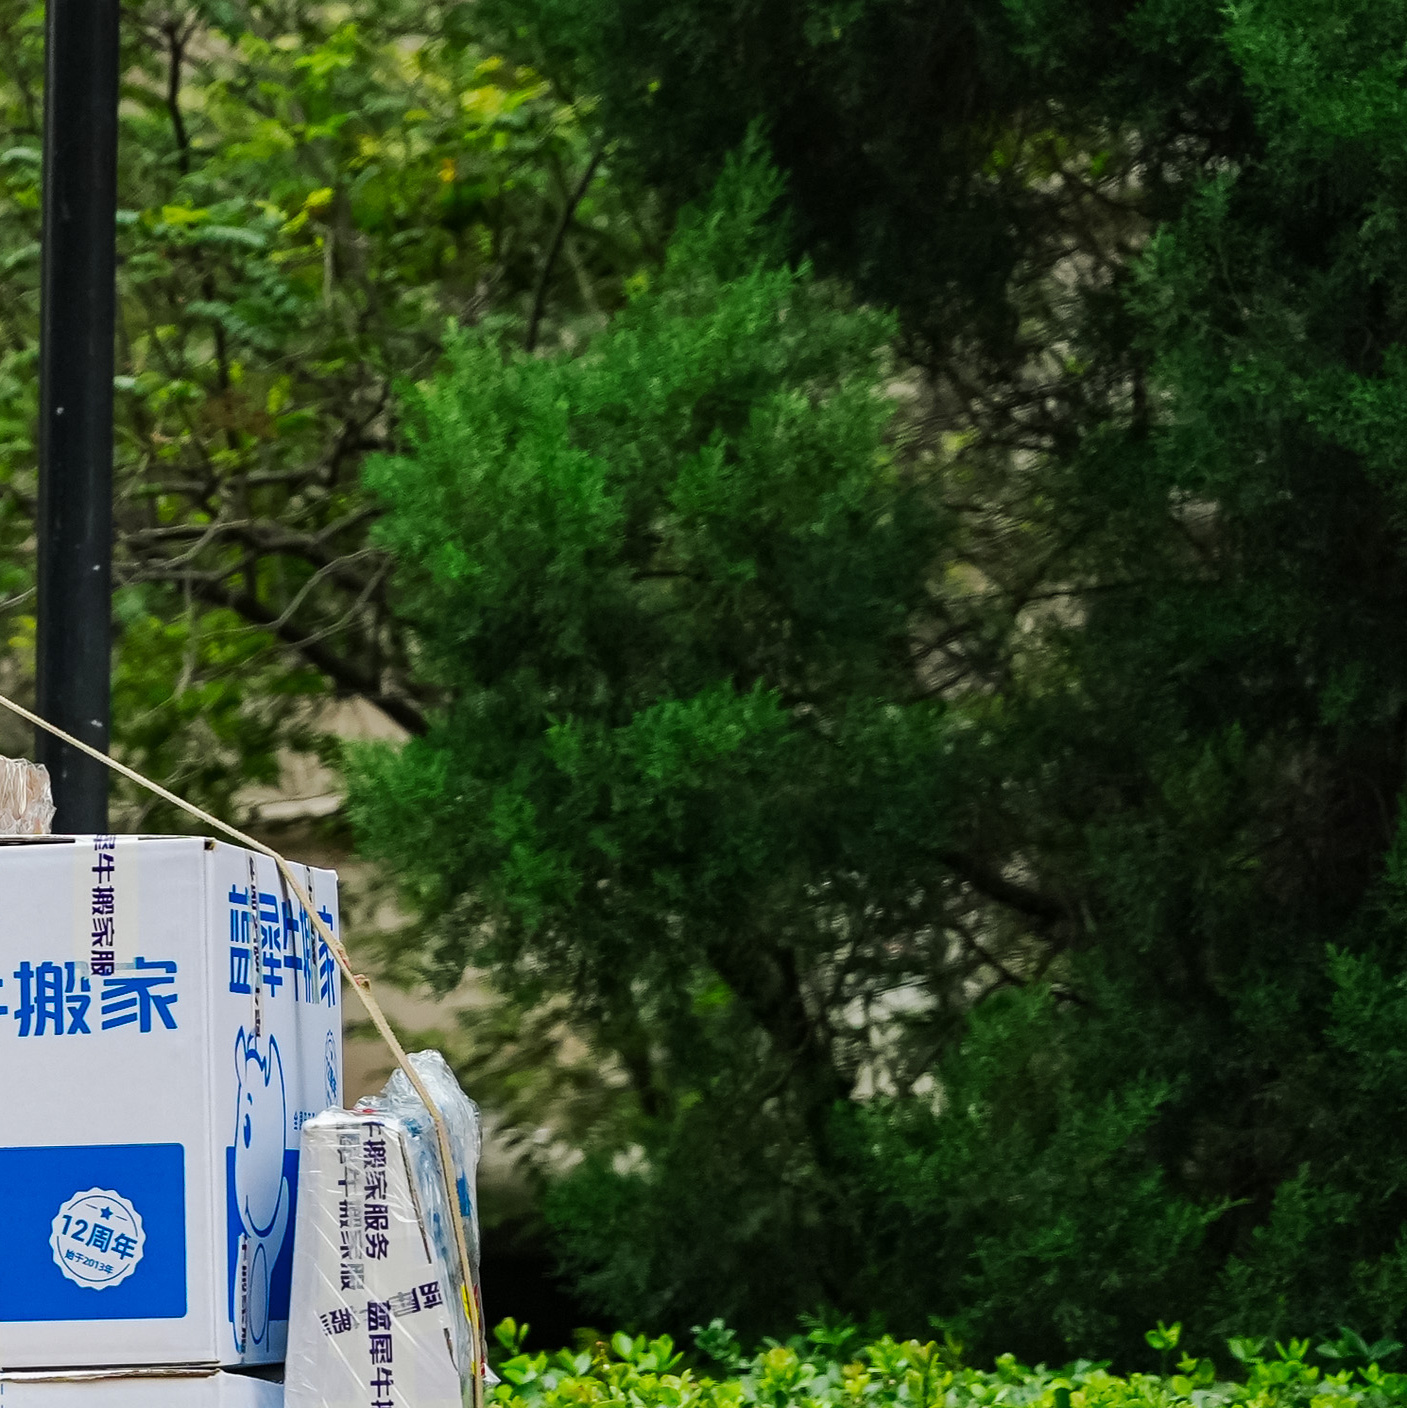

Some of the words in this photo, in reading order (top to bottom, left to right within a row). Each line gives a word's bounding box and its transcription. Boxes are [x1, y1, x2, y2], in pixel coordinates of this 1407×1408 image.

[62, 1214, 138, 1260] 12周年
[64, 1248, 114, 1274] 始于2013年
